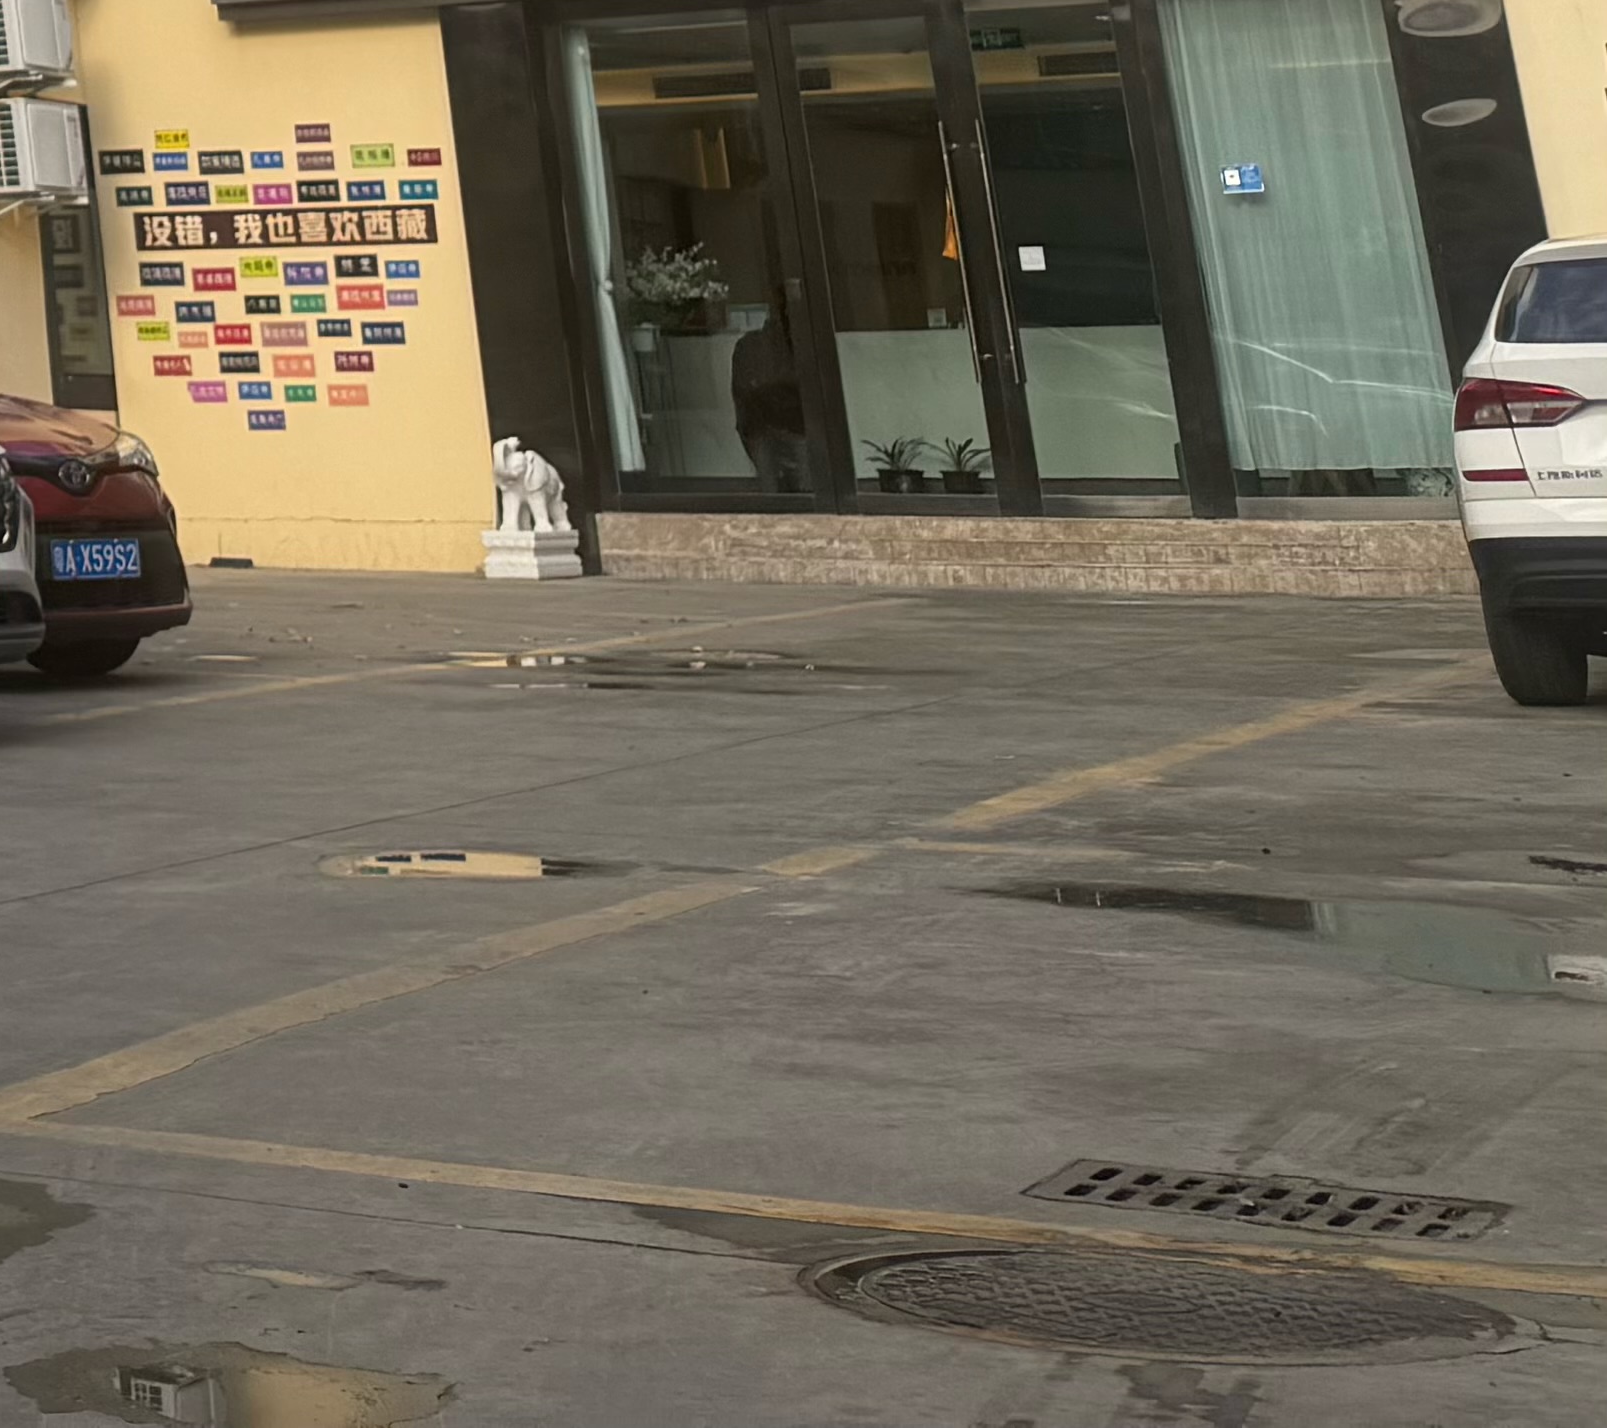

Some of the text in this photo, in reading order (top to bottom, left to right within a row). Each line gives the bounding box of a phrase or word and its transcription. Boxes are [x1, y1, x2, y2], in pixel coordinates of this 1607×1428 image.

[143, 209, 428, 246] 没错，我也喜欢西藏
